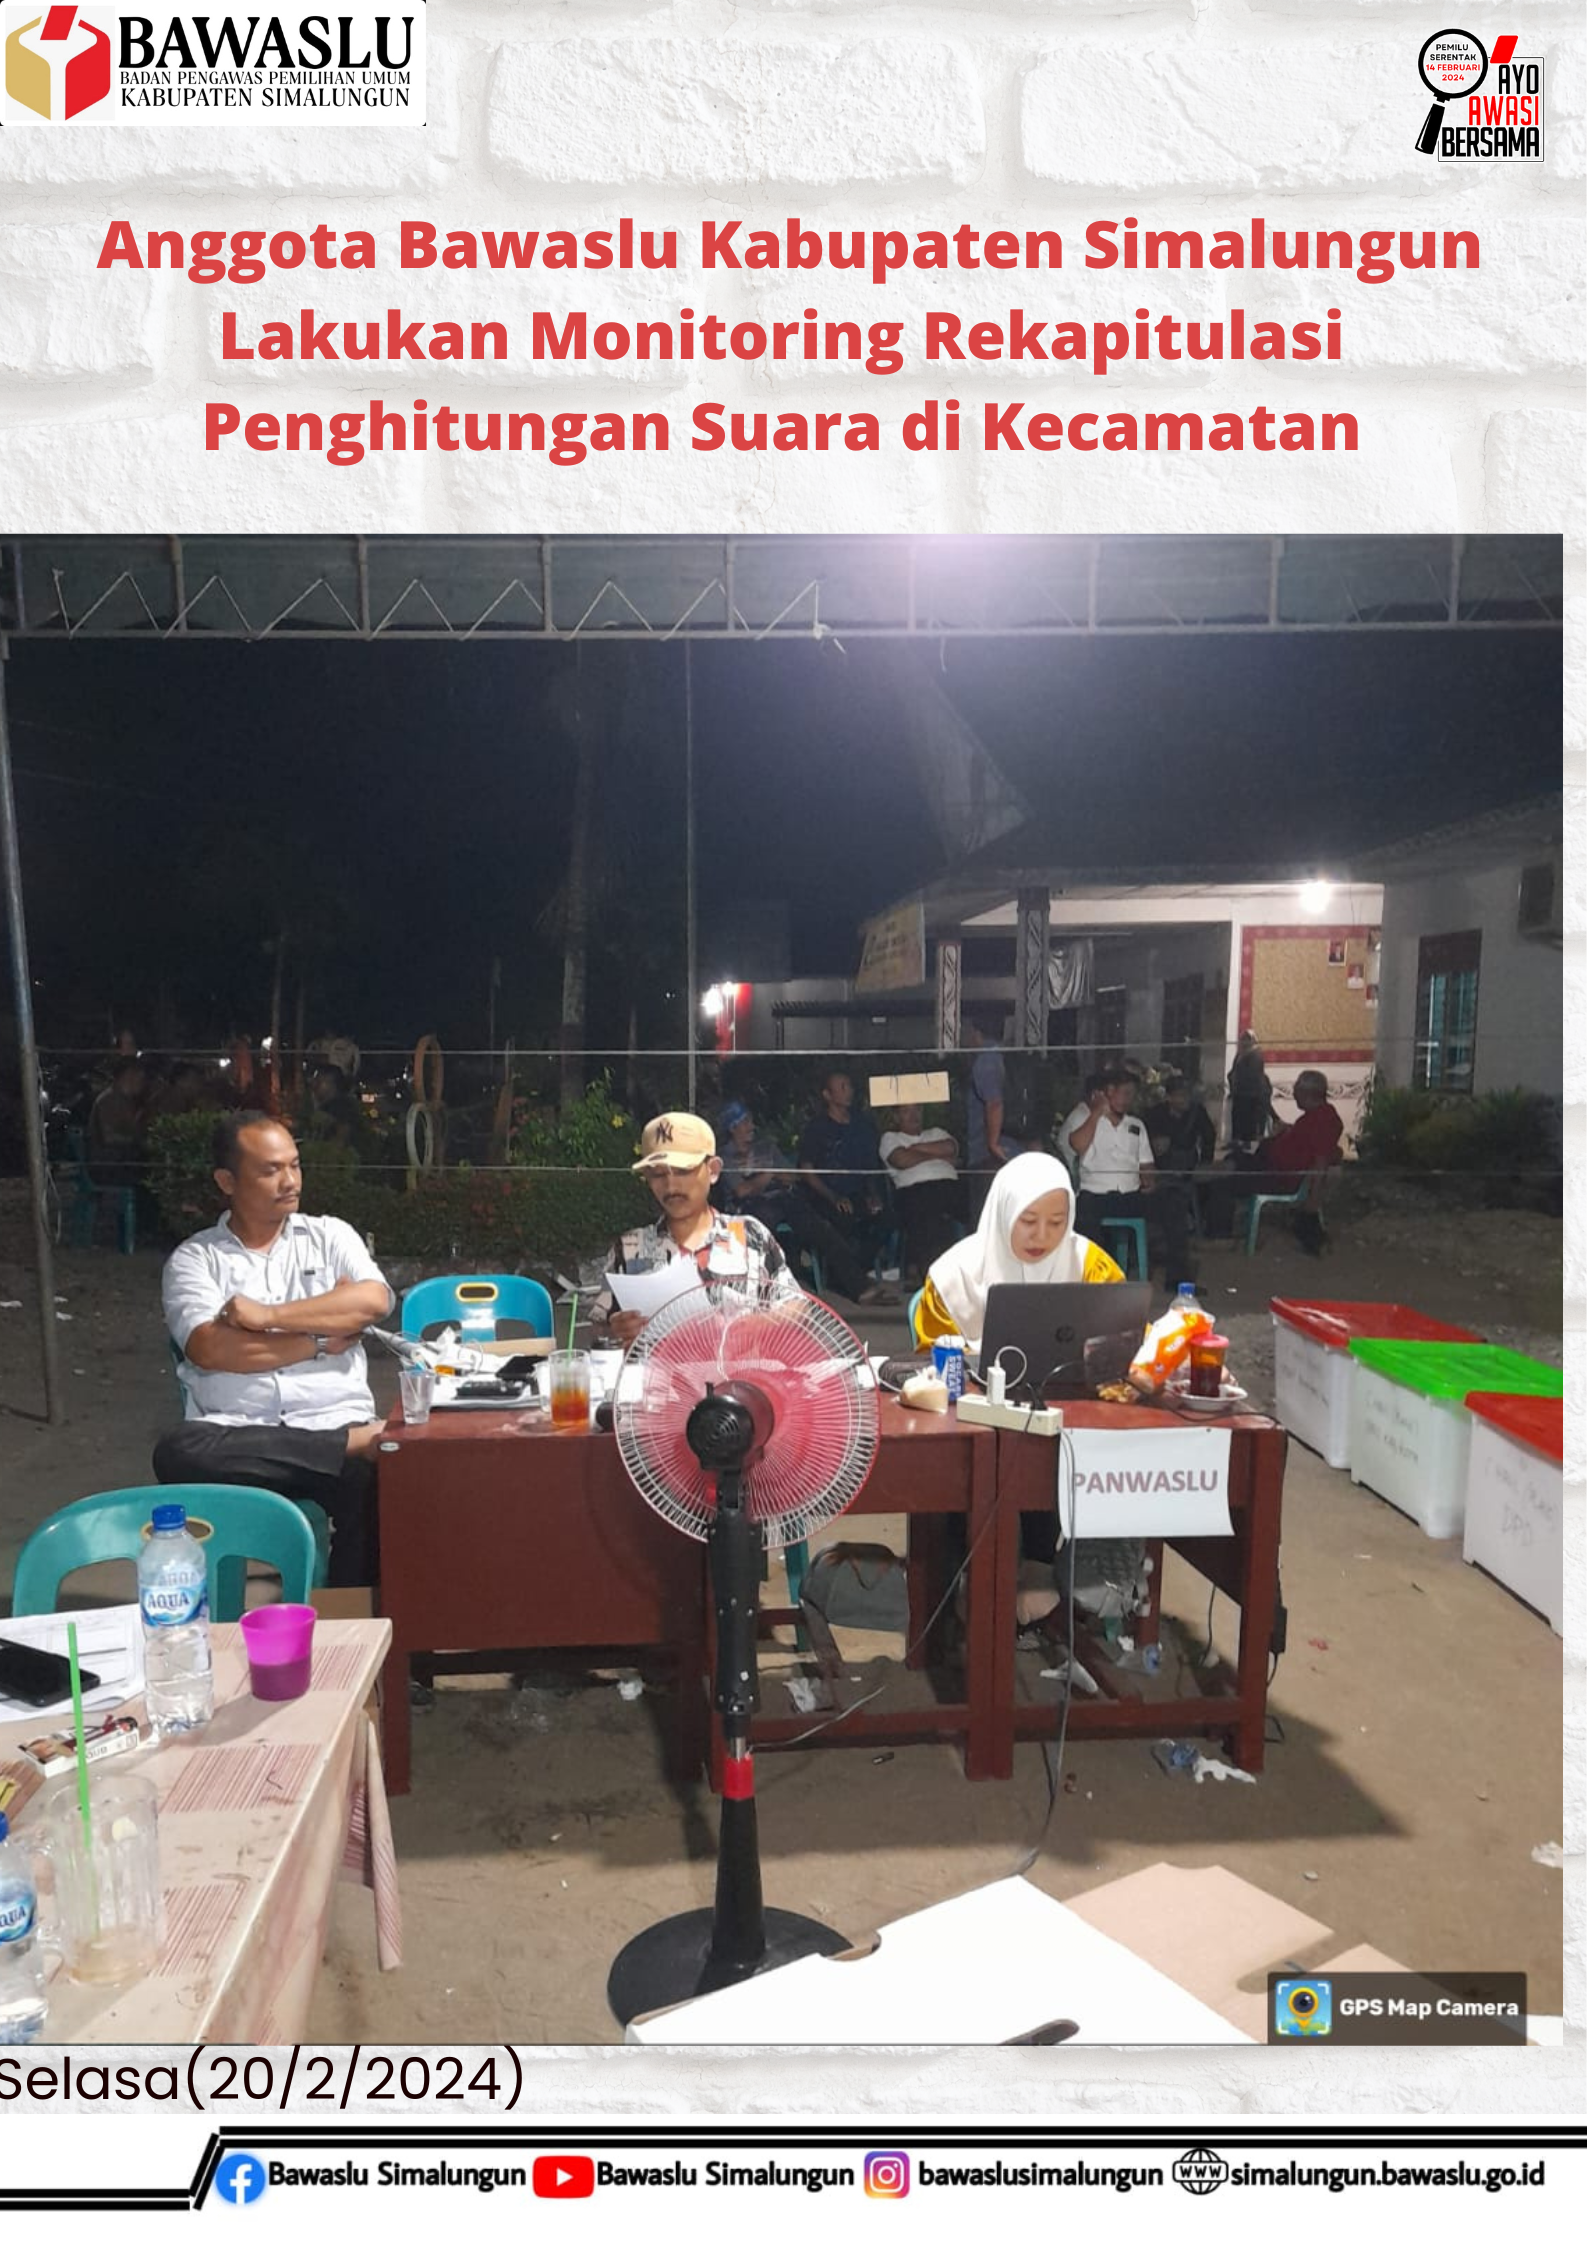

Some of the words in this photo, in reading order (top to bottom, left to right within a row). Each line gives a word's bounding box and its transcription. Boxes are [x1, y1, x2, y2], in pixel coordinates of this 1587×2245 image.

[1074, 1469, 1218, 1494] PANWASLU
[147, 1591, 189, 1610] AQUA
[0, 1905, 26, 1927] QUA
